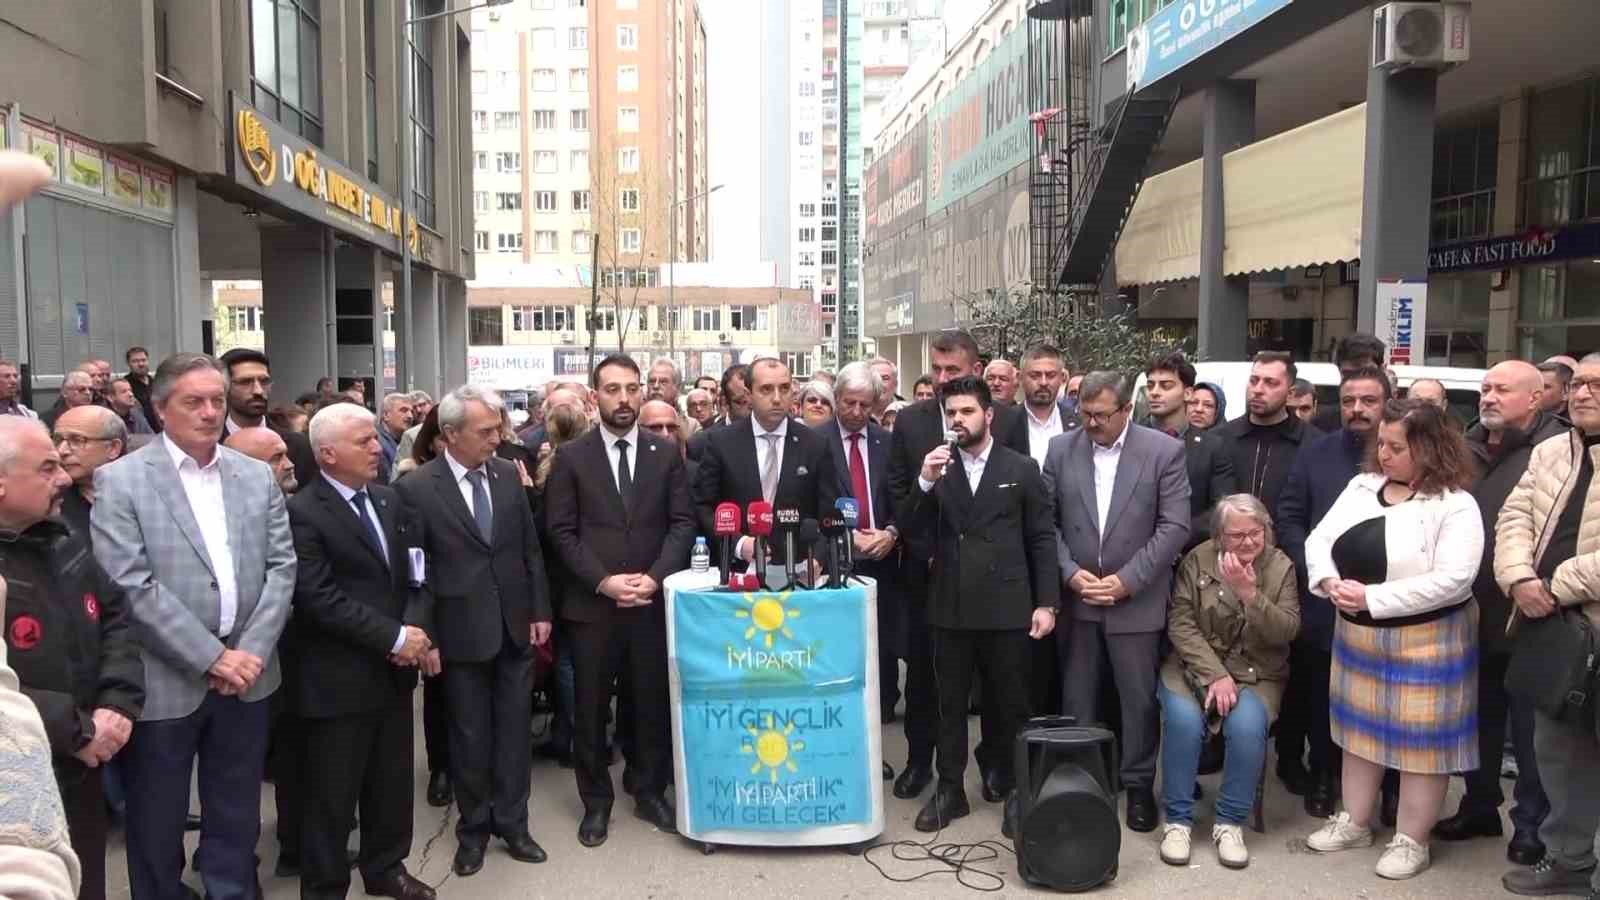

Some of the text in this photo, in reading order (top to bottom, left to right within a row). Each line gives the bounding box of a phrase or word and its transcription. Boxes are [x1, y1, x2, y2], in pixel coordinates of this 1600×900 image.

[1428, 237, 1556, 269] CAFE & FAST FOOD
[481, 356, 545, 369] BİLİMLERİ
[704, 701, 843, 734] İYİ GENÇLİK
